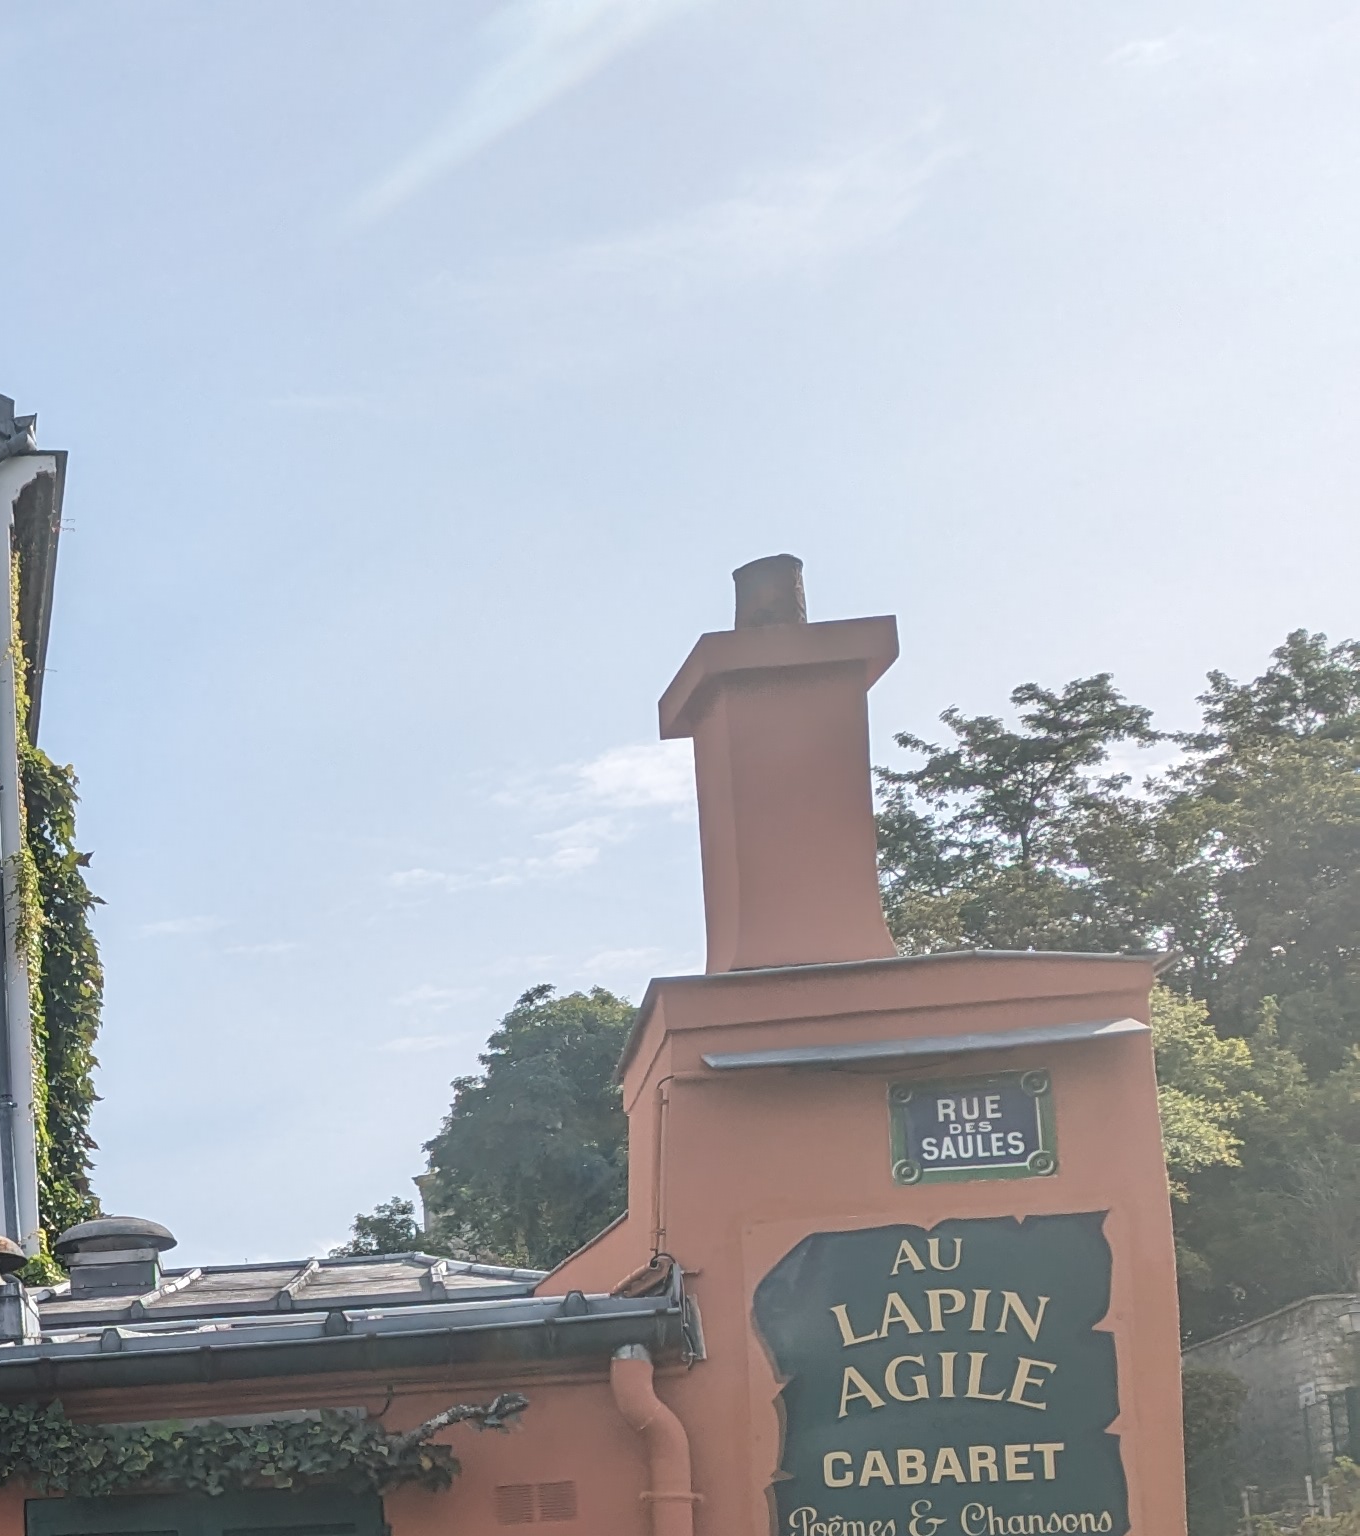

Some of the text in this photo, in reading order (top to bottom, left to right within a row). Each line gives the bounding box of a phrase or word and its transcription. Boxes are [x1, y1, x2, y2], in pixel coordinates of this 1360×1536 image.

[937, 1095, 1002, 1122] RUE
[949, 1121, 992, 1135] DES
[921, 1132, 1025, 1161] SAULES
[890, 1237, 963, 1276] AU
[830, 1288, 1051, 1347] LAPIN
[838, 1352, 1058, 1418] AGILE
[823, 1443, 1065, 1488] CABARET
[960, 1502, 1113, 1536] Chansons
